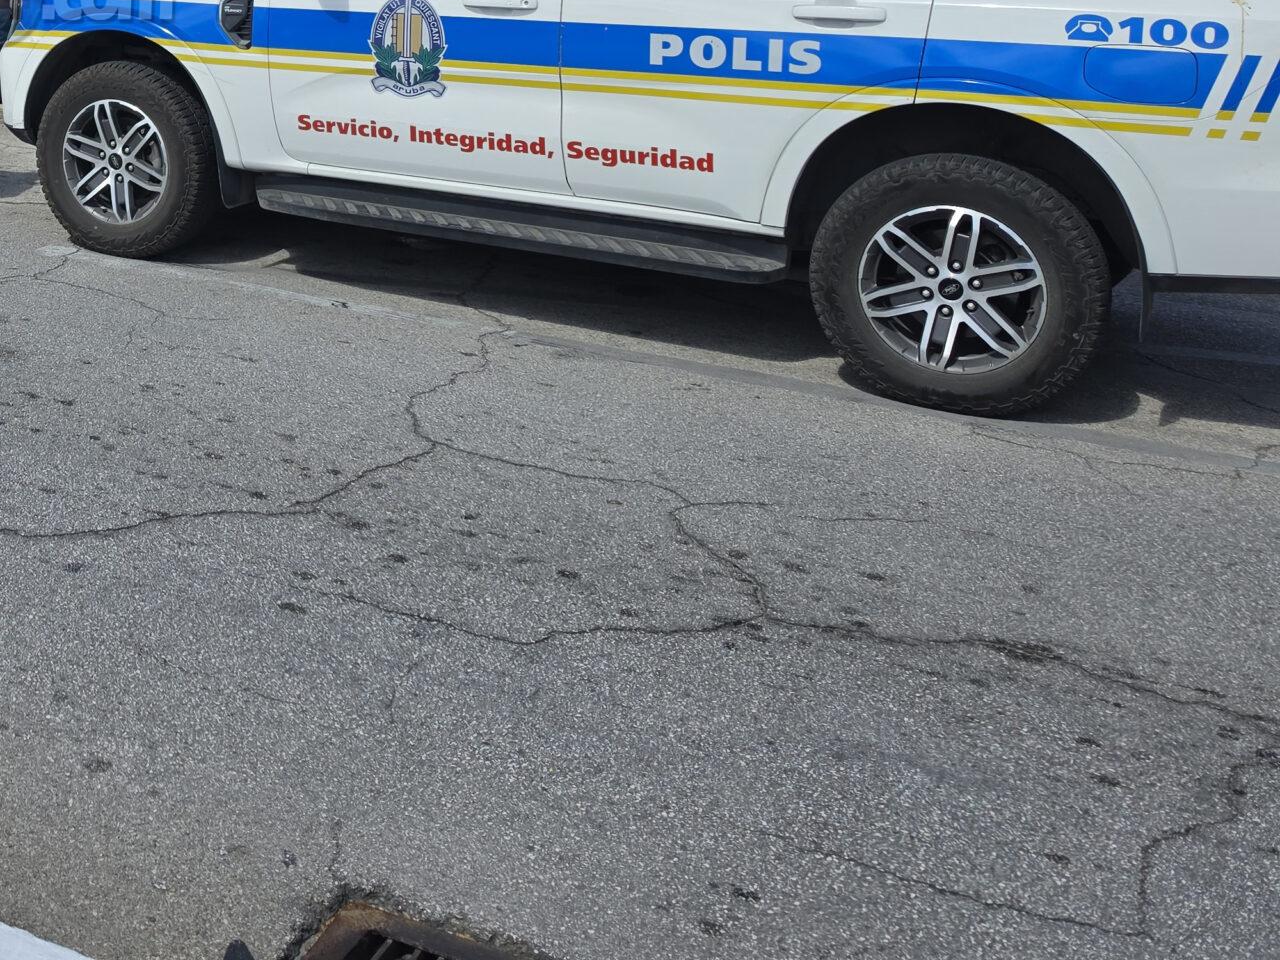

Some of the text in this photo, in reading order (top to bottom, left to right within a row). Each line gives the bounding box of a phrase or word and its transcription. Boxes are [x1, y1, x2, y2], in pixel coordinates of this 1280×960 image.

[376, 0, 440, 45] VIGILAT UT QUIESCANT
[1119, 17, 1229, 49] 100
[649, 32, 822, 74] POLIS
[393, 84, 425, 94] aruba
[297, 114, 714, 173] Servicio, Integridad, Seguridad
